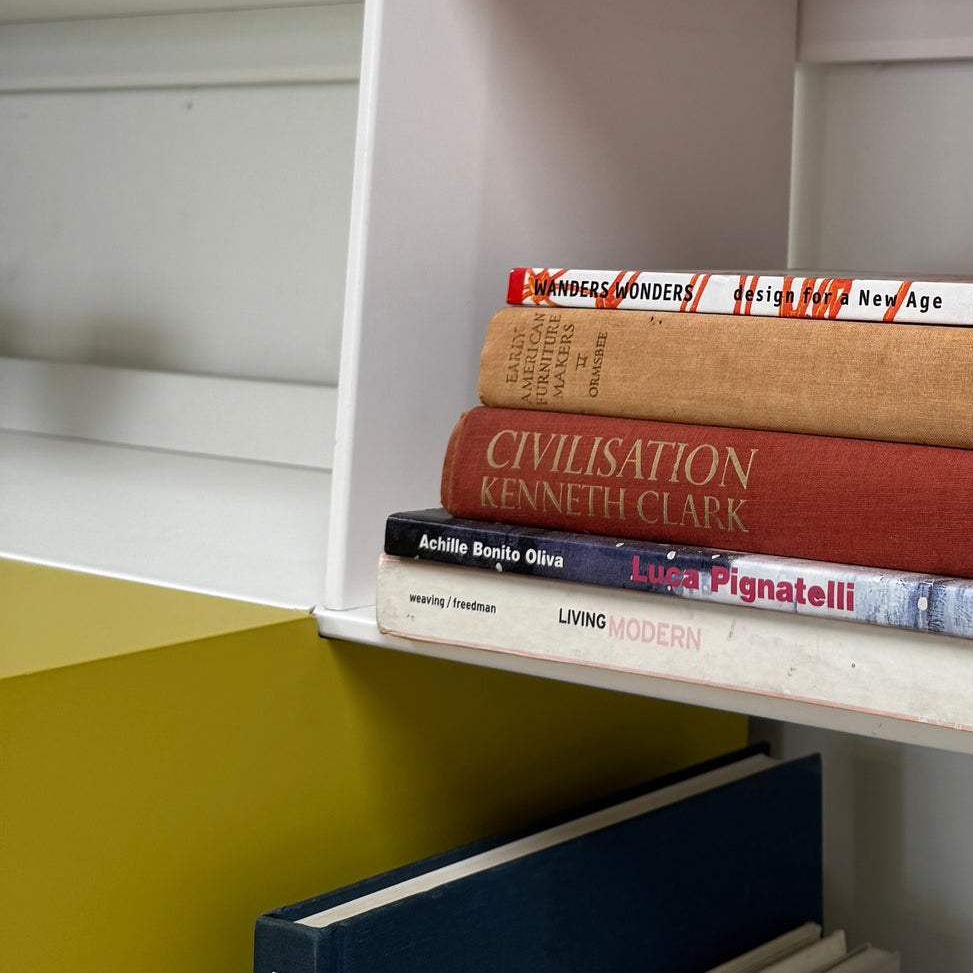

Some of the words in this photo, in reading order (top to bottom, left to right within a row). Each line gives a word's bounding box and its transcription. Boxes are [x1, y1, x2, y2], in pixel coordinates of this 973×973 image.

[534, 279, 609, 298] WANDERS
[615, 282, 694, 302] WONDERS
[734, 285, 794, 307] design
[803, 287, 832, 305] for
[840, 292, 849, 305] a
[859, 289, 898, 307] New
[906, 291, 943, 313] Age
[506, 327, 526, 383] EARLY
[521, 313, 546, 404] AMERICAN
[536, 314, 561, 405] FURNITURE
[553, 323, 575, 399] MAKERS
[589, 331, 608, 398] ORMSBEE
[486, 429, 759, 490] CIVILISATION
[480, 476, 626, 520] KENNETH
[637, 490, 749, 533] CLARK
[419, 534, 468, 555] Achille
[473, 541, 521, 562] Bonito
[525, 548, 564, 568] Oliva
[409, 593, 445, 609] weaving
[453, 598, 497, 614] freedman
[631, 555, 699, 590] Luca
[711, 565, 855, 612] Pignatelli
